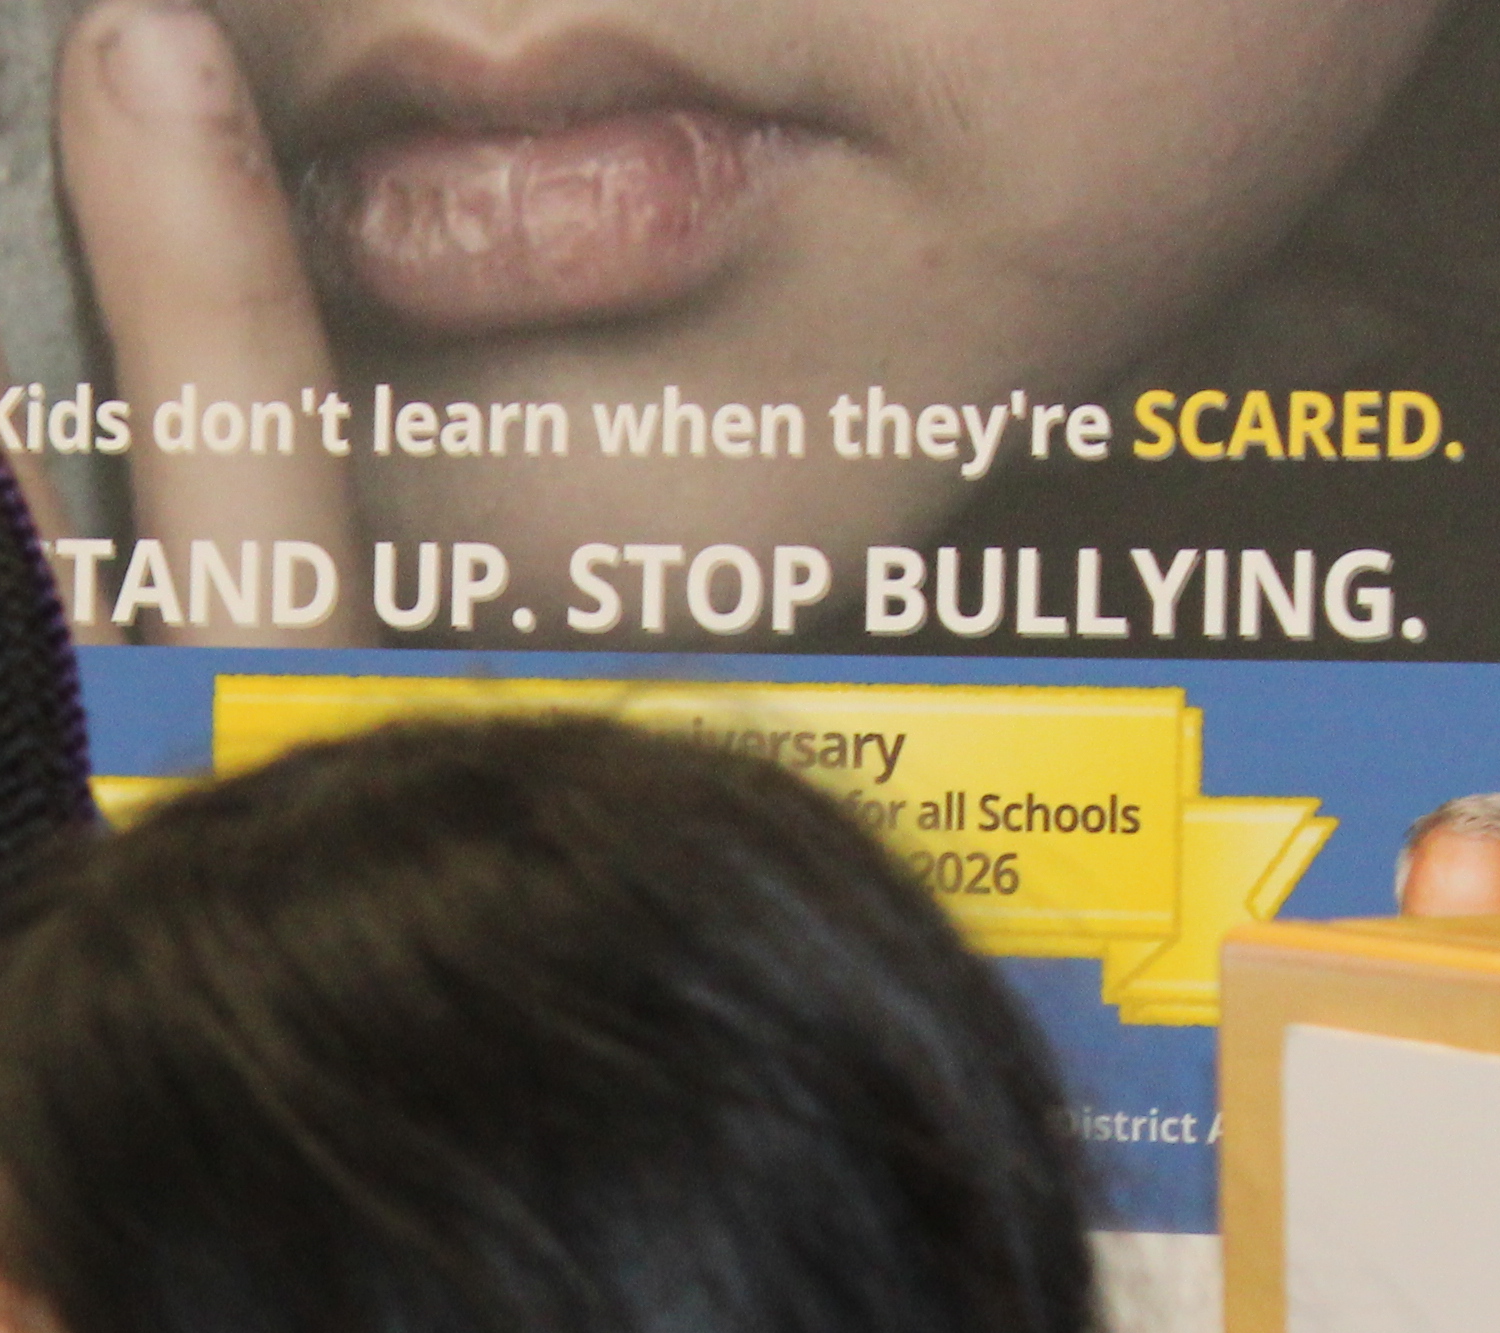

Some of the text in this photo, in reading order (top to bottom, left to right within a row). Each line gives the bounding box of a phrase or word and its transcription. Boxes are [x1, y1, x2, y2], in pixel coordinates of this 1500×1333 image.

[152, 384, 353, 456] don't
[373, 385, 569, 456] learn
[593, 385, 804, 458] when
[829, 386, 1110, 481] they're
[1133, 390, 1464, 462] SCARED.
[42, 537, 1429, 642] TAND UP. STOP BULLYING.
[917, 791, 966, 833] all
[978, 793, 1141, 835] Schools
[914, 851, 1020, 896] 2026
[1068, 1105, 1198, 1145] istrict
